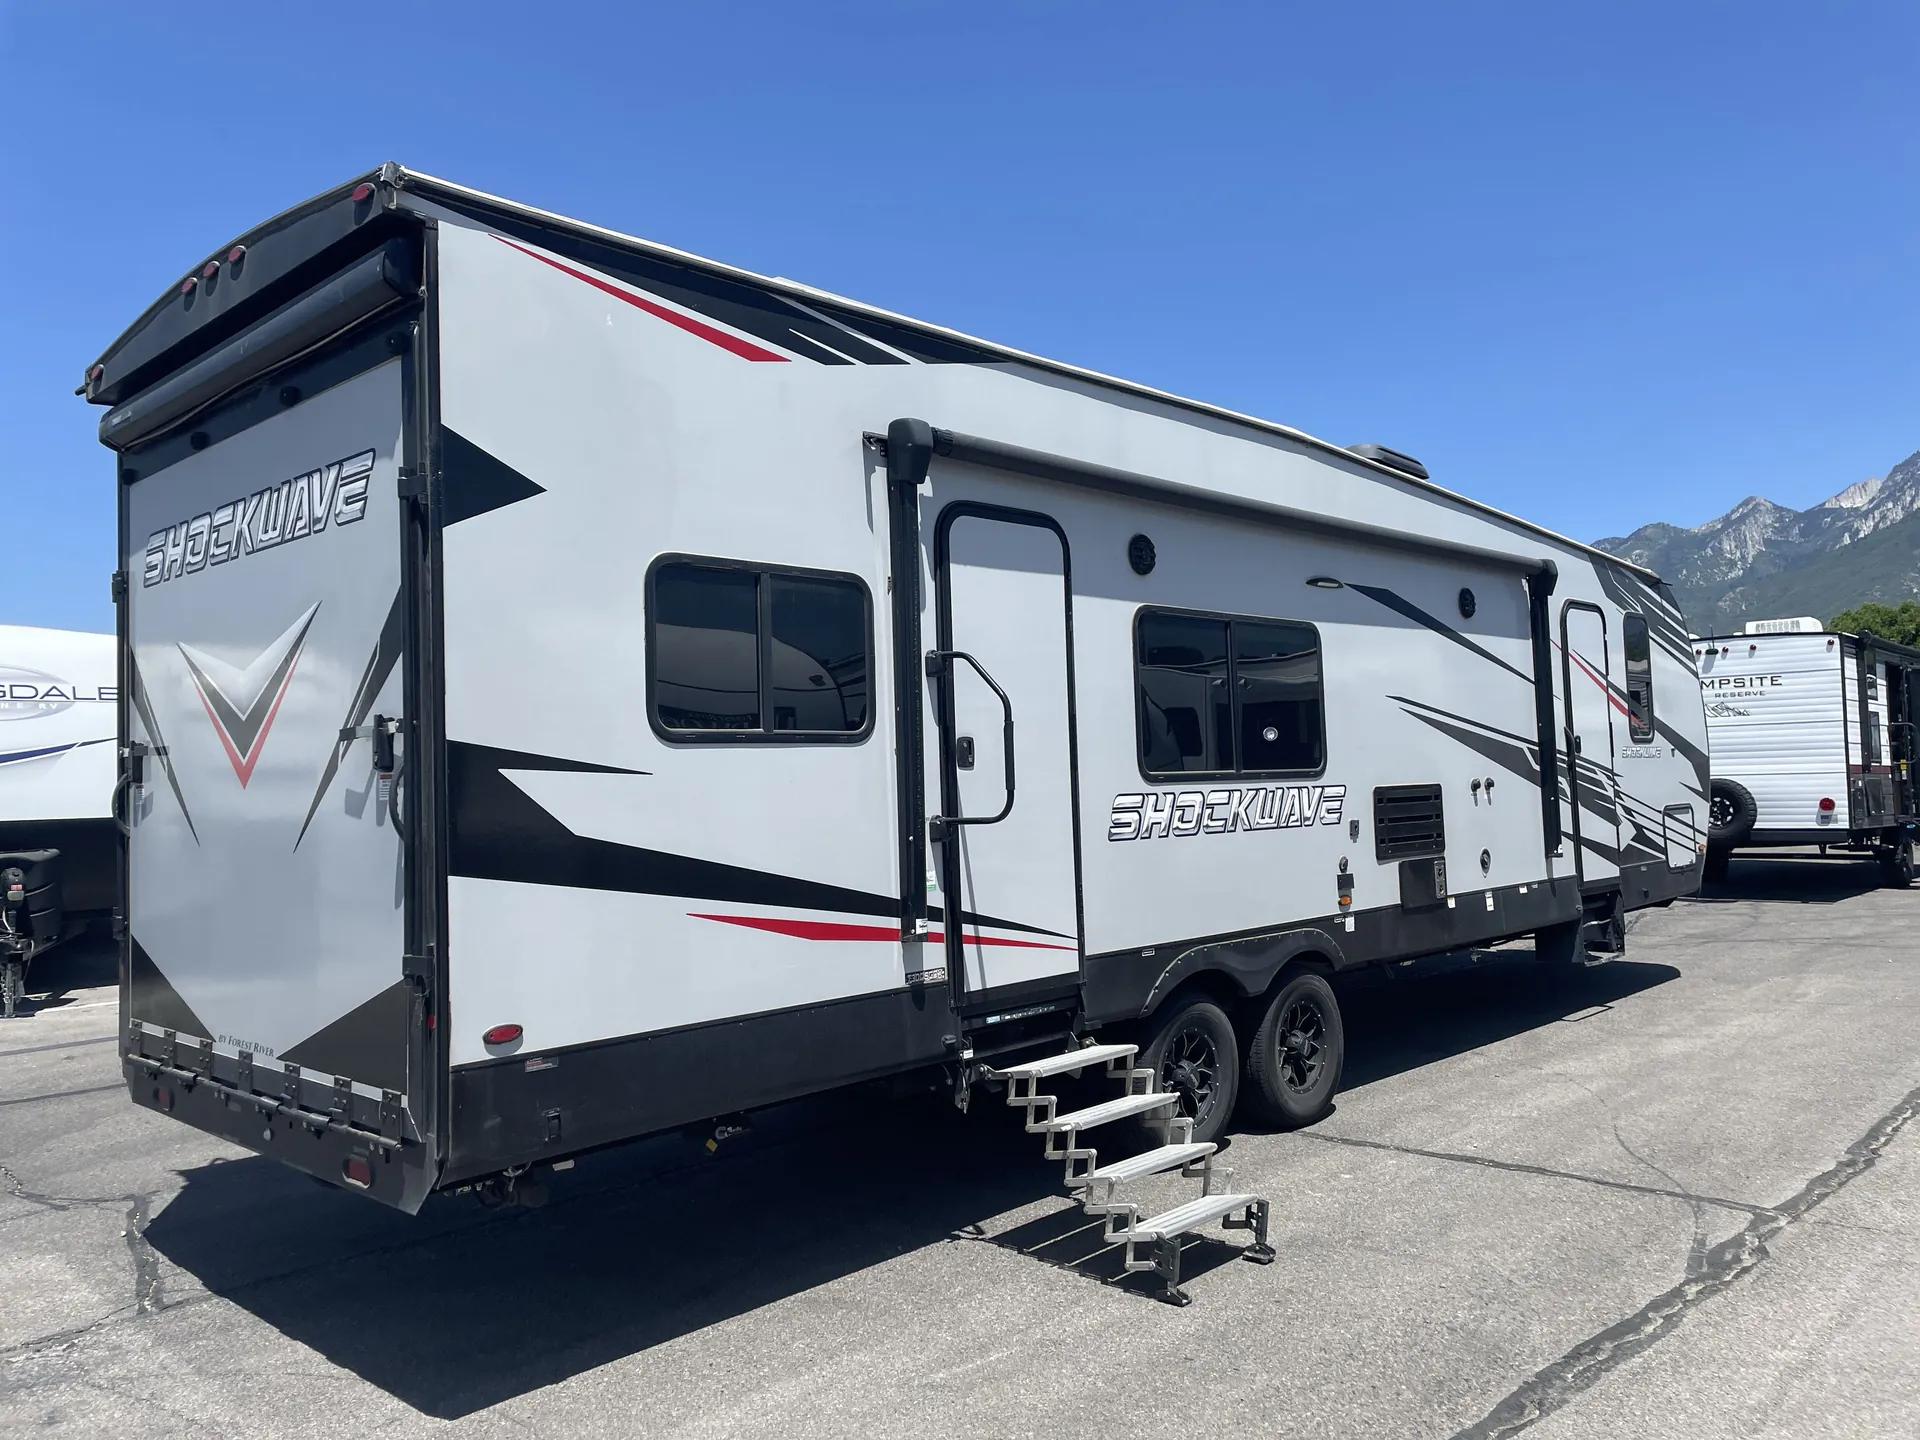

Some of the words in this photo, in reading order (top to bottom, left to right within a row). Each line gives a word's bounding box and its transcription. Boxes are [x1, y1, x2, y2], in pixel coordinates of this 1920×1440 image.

[144, 447, 377, 588] SHOCKWAVE
[0, 683, 118, 701] DALE
[1714, 690, 1766, 698] RESERVE
[1107, 784, 1347, 842] SHOCKWAVE
[228, 1035, 253, 1051] FOREST
[253, 1042, 275, 1057] RIVER
